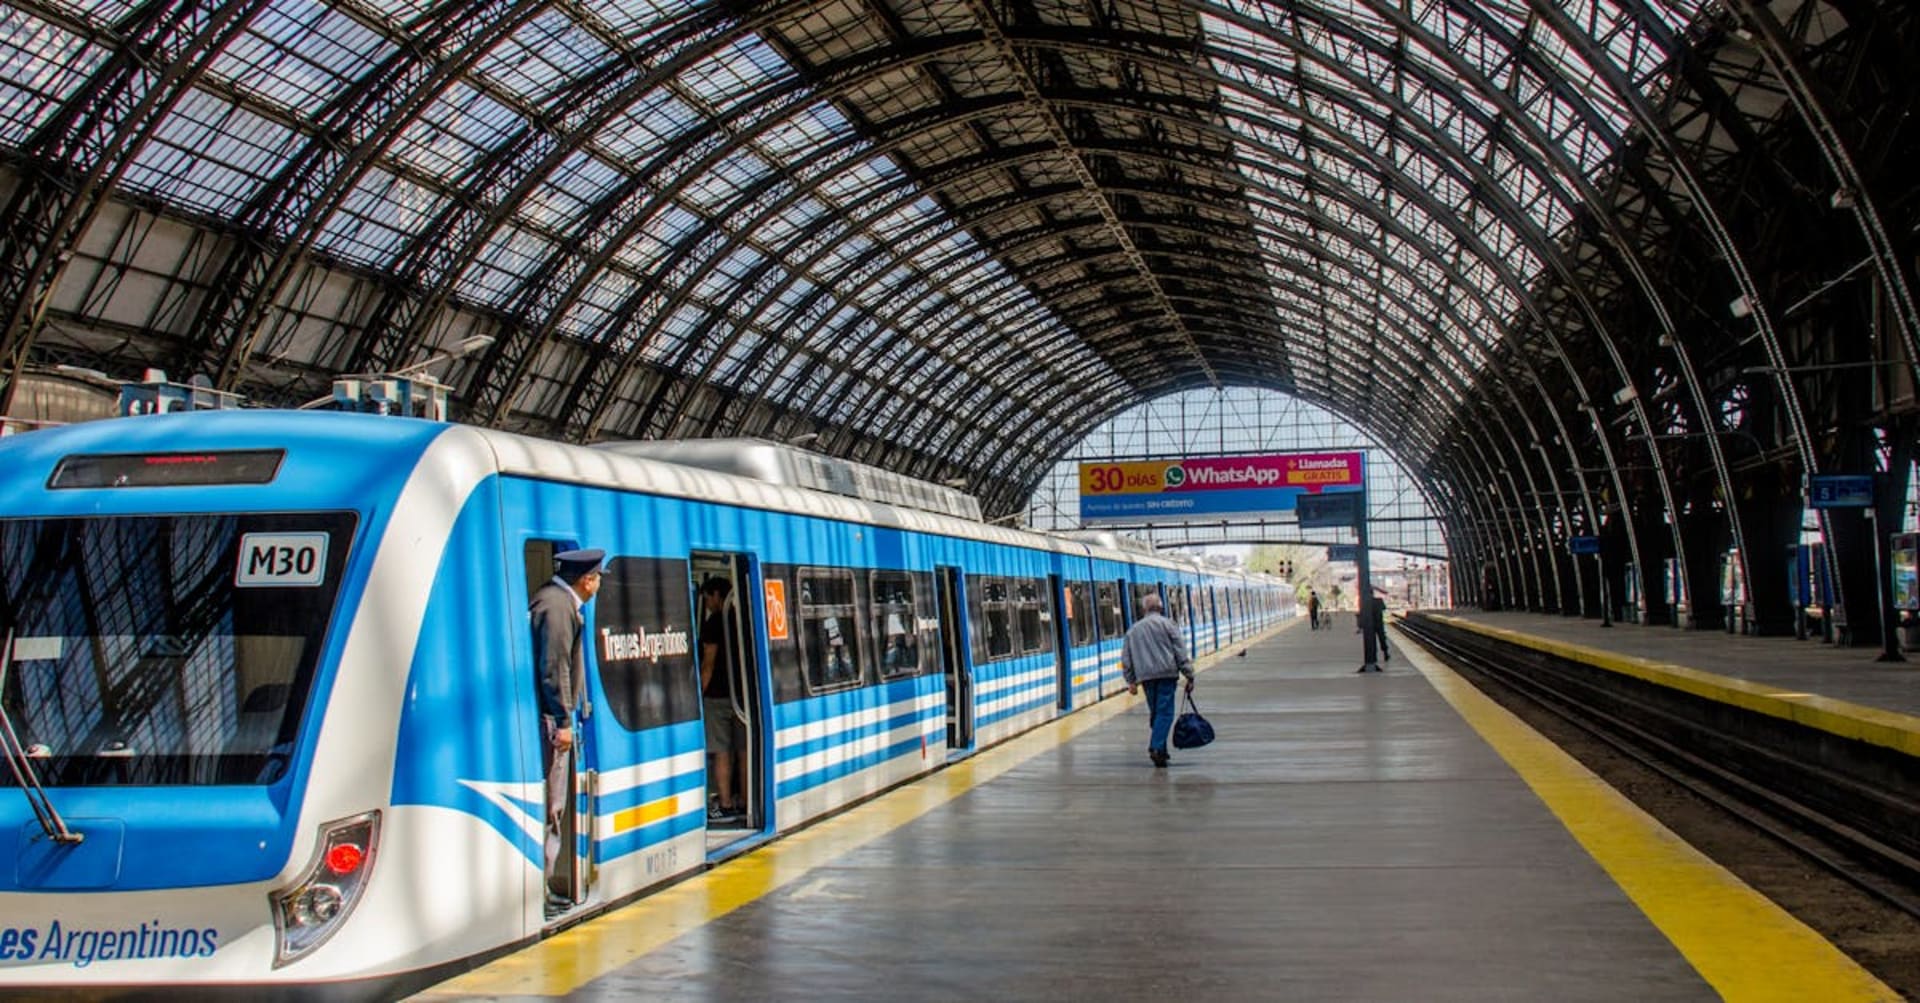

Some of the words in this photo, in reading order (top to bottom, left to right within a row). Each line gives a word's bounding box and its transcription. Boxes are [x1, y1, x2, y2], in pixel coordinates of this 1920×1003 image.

[1187, 464, 1280, 485] WhatsApp
[1298, 457, 1348, 469] Llamadas
[1303, 470, 1343, 481] GRATIS
[1089, 466, 1124, 493] 30
[1127, 473, 1157, 487] DÍAS
[247, 545, 316, 576] M30
[601, 627, 640, 662] Trenes
[640, 625, 689, 664] Argentinos
[39, 919, 218, 968] Argentinos
